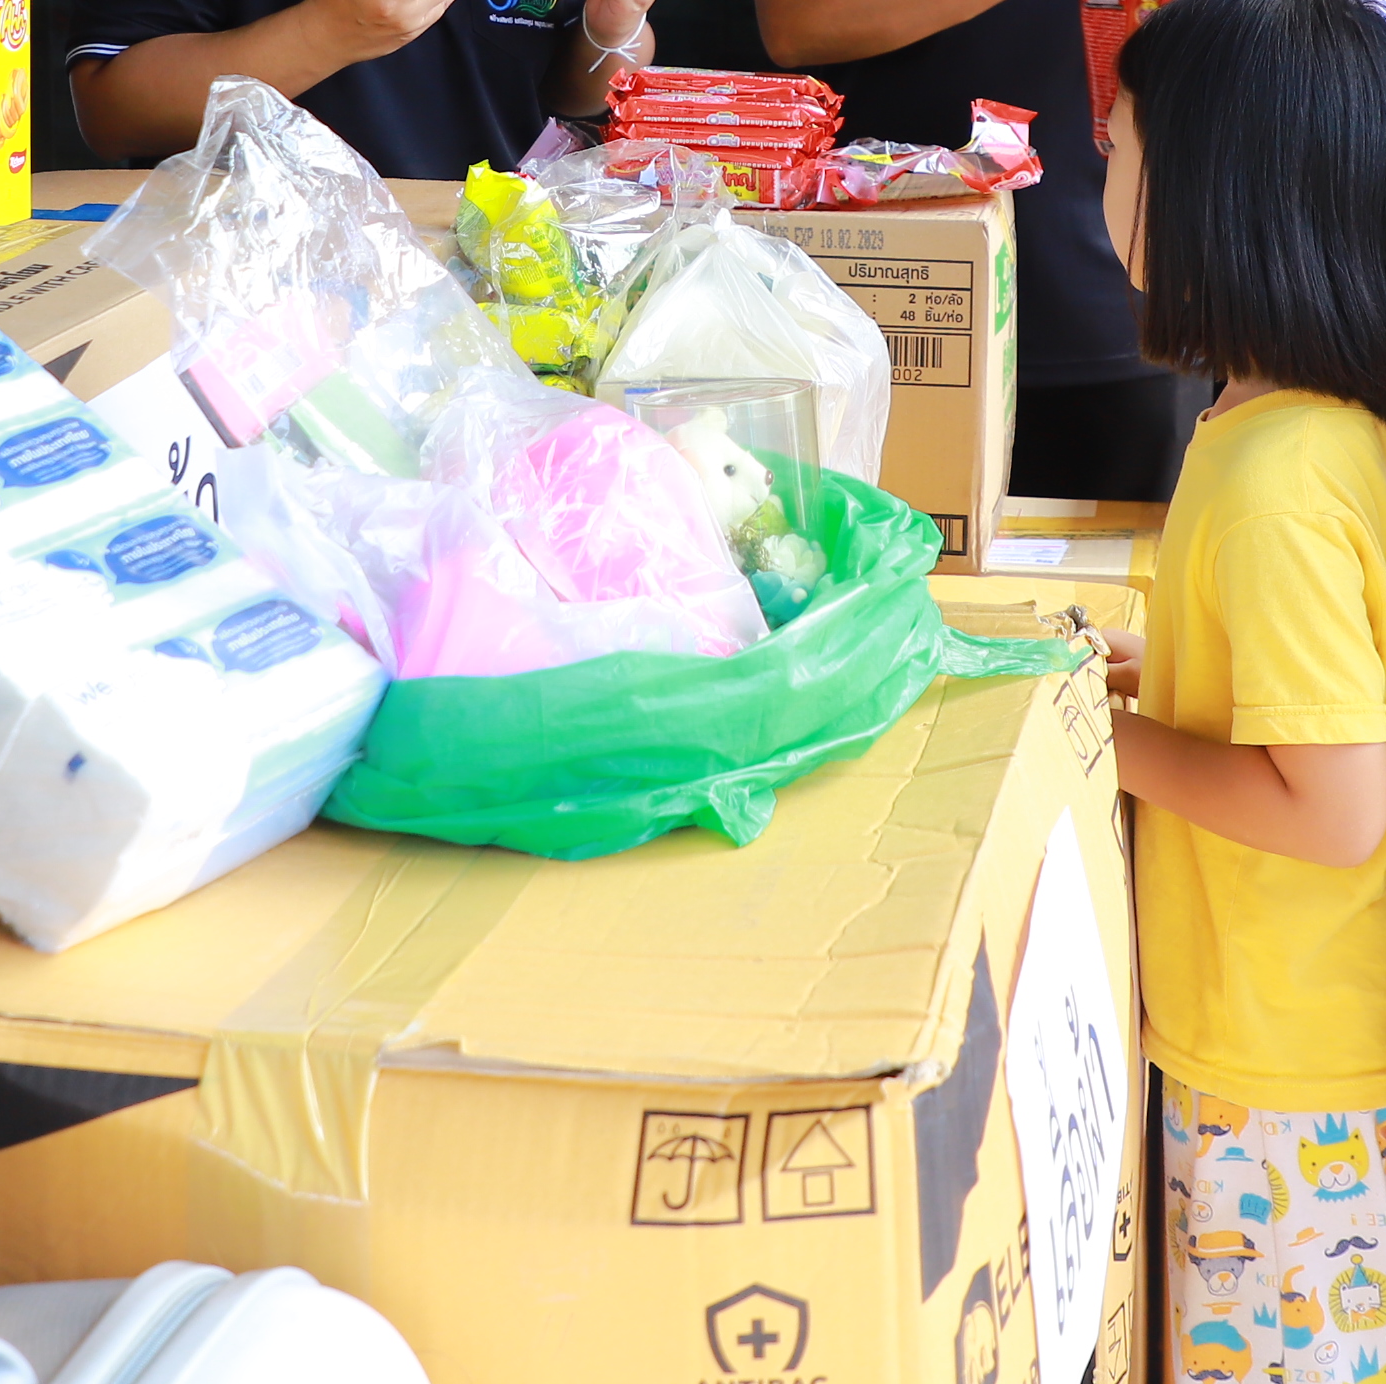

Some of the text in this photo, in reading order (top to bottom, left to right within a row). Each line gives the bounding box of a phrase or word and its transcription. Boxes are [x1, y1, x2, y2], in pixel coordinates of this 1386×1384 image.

[848, 262, 930, 285] ปริมาณสุทธิ
[20, 275, 78, 296] WITH
[908, 293, 916, 304] 2
[924, 290, 964, 307] ห่อ/ลัง
[899, 310, 916, 322] 48
[924, 305, 964, 324] ชิ้น/ห่อ
